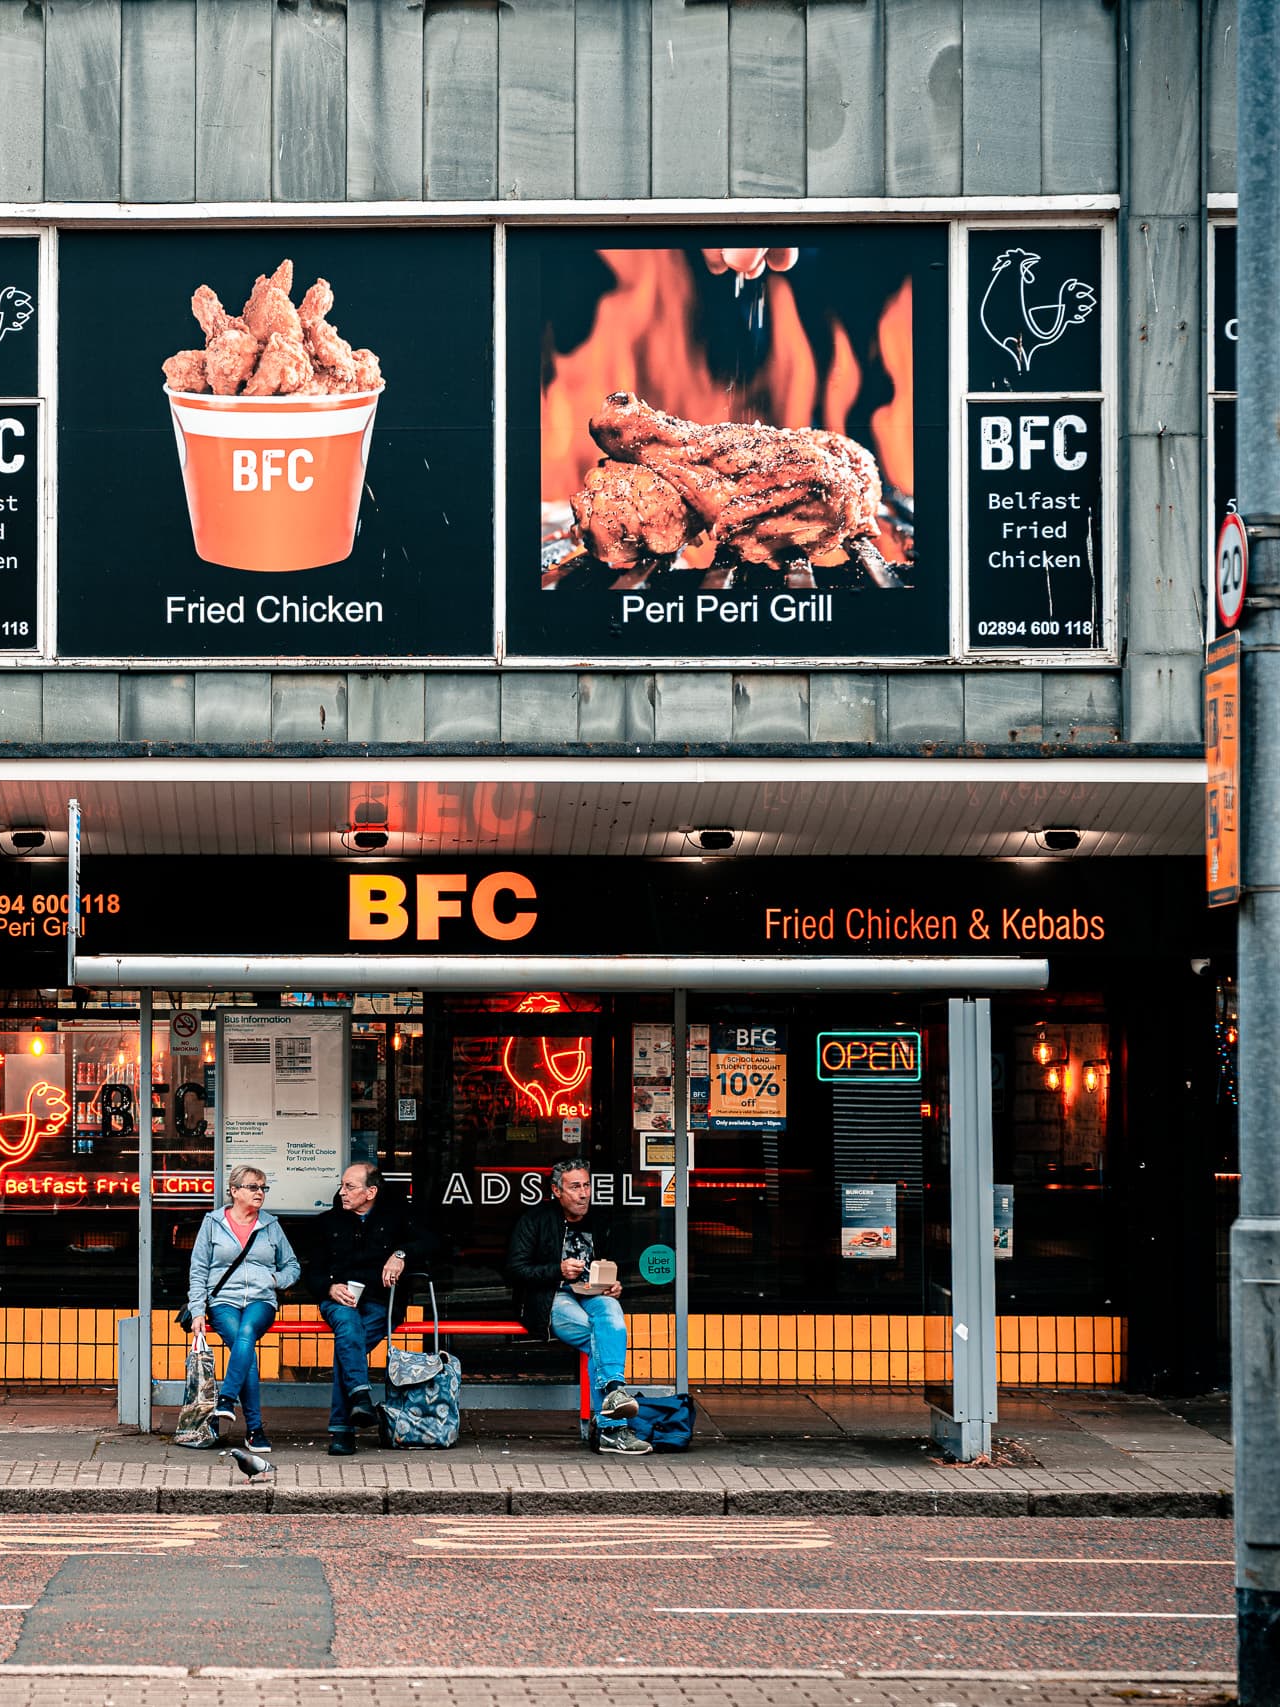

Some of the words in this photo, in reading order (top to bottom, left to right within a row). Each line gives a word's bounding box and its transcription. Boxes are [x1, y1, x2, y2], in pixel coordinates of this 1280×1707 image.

[979, 415, 1088, 472] BFC
[232, 448, 315, 493] BFC
[987, 491, 1082, 511] Belfast
[1001, 520, 1068, 540] Fried
[987, 550, 1082, 570] Chicken
[1222, 545, 1243, 596] 20
[166, 595, 246, 624] Fried
[256, 595, 384, 624] Chicken
[622, 595, 686, 624] Peri
[696, 595, 760, 624] Peri
[769, 594, 834, 624] Grill
[1, 621, 29, 637] 118
[978, 621, 1026, 638] 02894
[1030, 621, 1060, 638] 600
[1064, 621, 1092, 638] 118
[81, 894, 120, 914] 118
[348, 871, 539, 942] BFC
[43, 917, 86, 937] Grl
[766, 907, 835, 942] Fried
[846, 907, 958, 942] Chicken
[968, 907, 991, 942] &
[1001, 907, 1106, 942] Kebabs
[224, 1016, 240, 1024] Bus
[241, 1015, 292, 1024] Information
[736, 1028, 777, 1046] BFC
[821, 1041, 916, 1071] OPEN
[716, 1072, 781, 1097] 10%
[740, 1098, 757, 1107] off
[5, 1176, 88, 1195] Belfast
[442, 1172, 646, 1206] ADSEL
[647, 1256, 670, 1264] Uber
[648, 1266, 670, 1274] Eats
